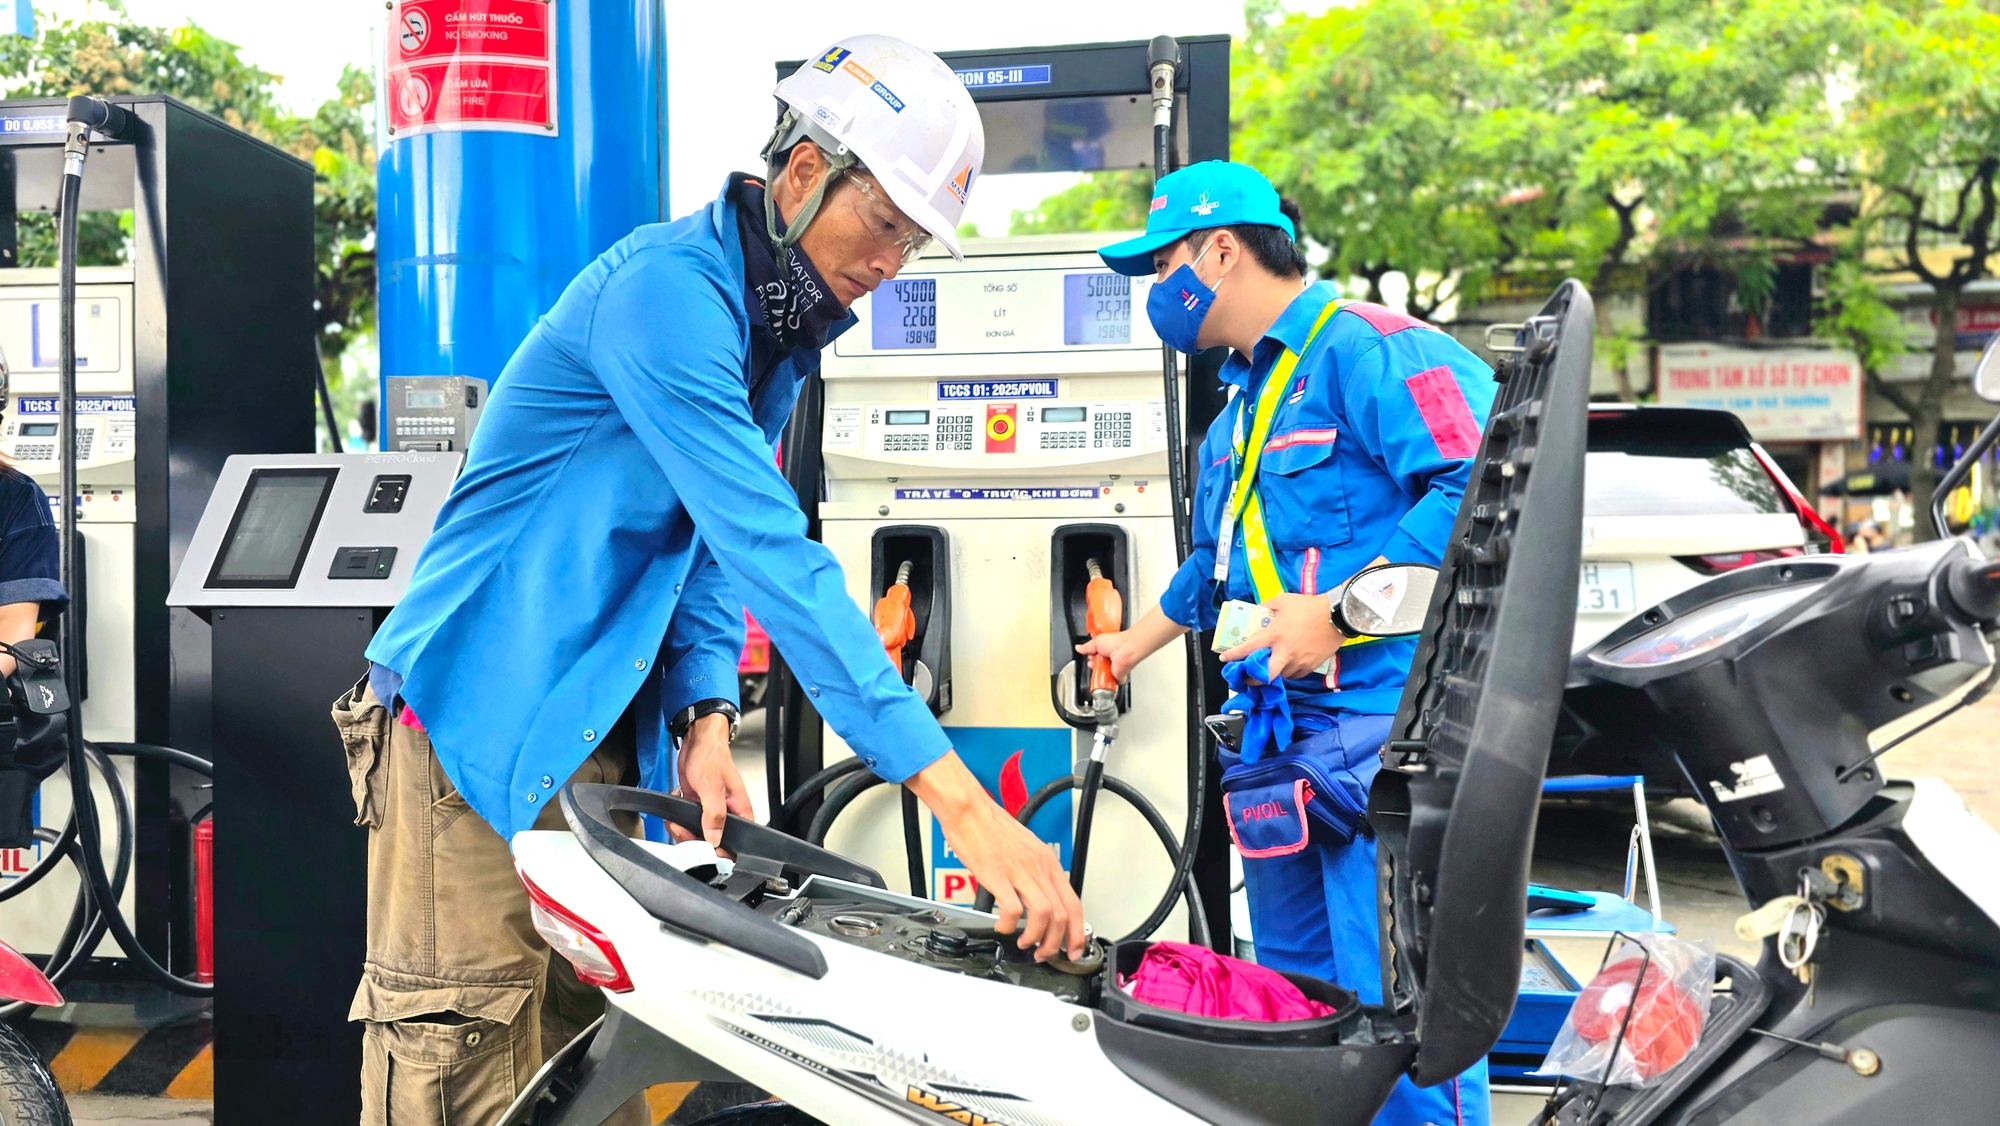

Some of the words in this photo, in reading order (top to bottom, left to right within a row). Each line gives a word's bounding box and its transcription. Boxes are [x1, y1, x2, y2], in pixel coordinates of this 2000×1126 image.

[445, 10, 467, 22] CẤM
[469, 11, 487, 22] HÚT
[489, 12, 523, 24] THUỐC
[445, 31, 459, 40] NO
[462, 30, 508, 41] SMOKING
[987, 69, 1023, 84] 95-III
[447, 97, 461, 105] NO
[463, 97, 485, 105] FIRE
[873, 83, 902, 108] GROUP
[5, 119, 20, 131] DO
[895, 281, 936, 303] 45000
[1006, 282, 1018, 293] SỐ
[1087, 275, 1130, 297] 50000
[994, 307, 1006, 317] LÍT
[905, 330, 936, 344] 19840
[1098, 324, 1130, 339] 19840
[943, 384, 971, 397] TCCS
[972, 384, 989, 396] 01:
[991, 382, 1052, 396] 2025/PVOIL
[24, 400, 52, 411] TCCS
[365, 454, 406, 464] PETRO
[407, 453, 437, 463] Cloud
[903, 488, 931, 499] TRẢ
[1032, 489, 1057, 498] KHI
[1060, 488, 1093, 498] BƠM
[1578, 588, 1620, 610] .31
[1242, 800, 1288, 825] PVOIL
[752, 1035, 793, 1056] FASHION
